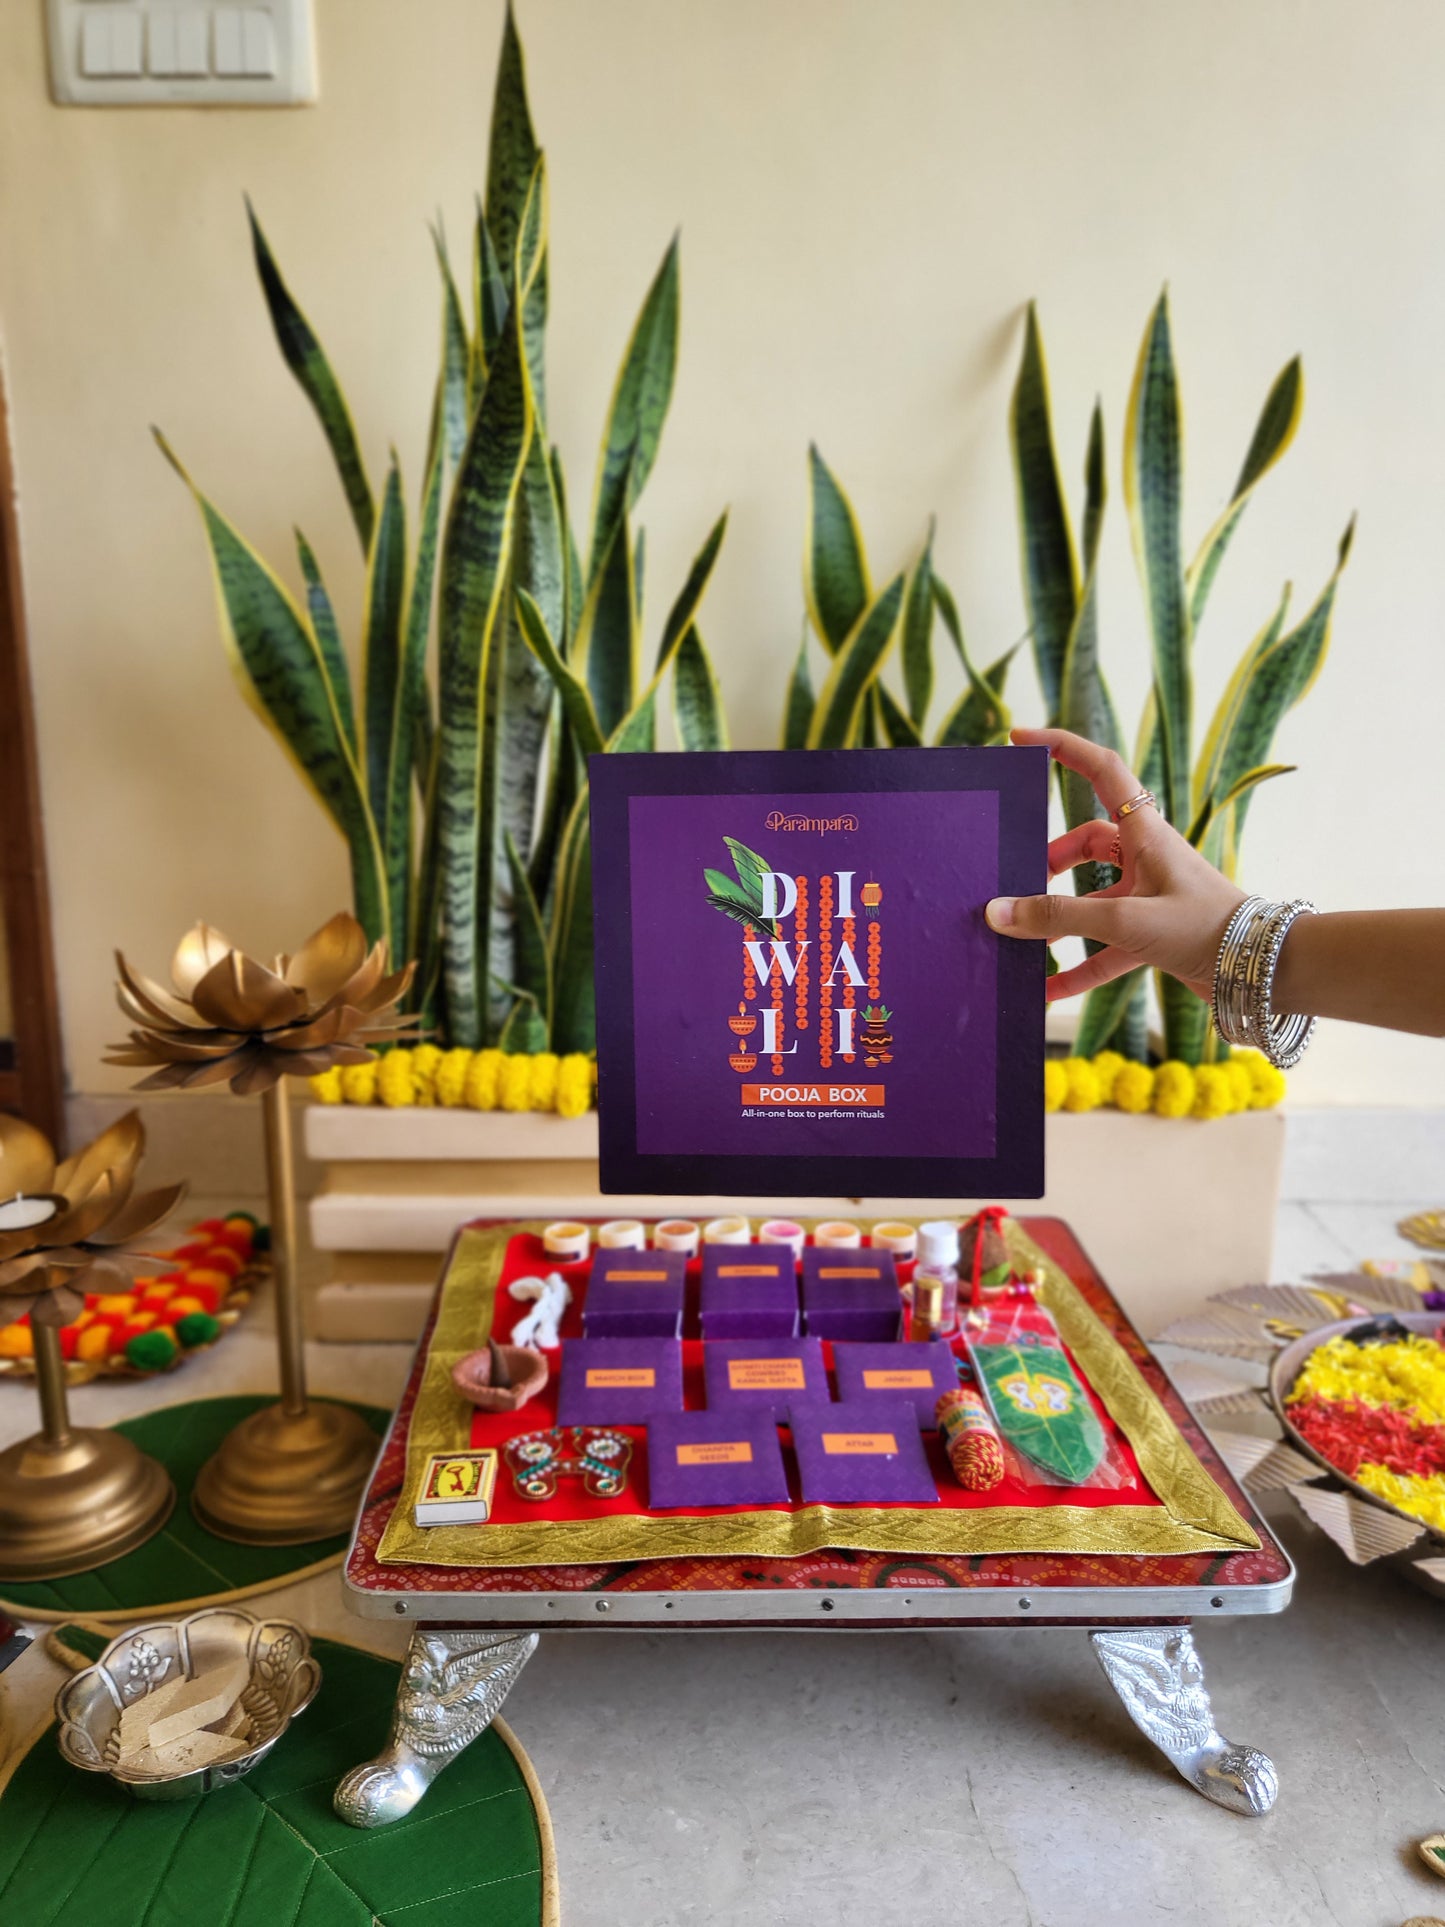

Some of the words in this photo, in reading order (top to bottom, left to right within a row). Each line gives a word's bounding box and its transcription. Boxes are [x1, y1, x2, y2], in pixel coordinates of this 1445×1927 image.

[765, 811, 859, 836] Parampara
[760, 1087, 821, 1102] POOJA
[829, 1087, 867, 1102] BOX
[741, 1109, 786, 1118] All-in-one
[787, 1109, 804, 1118] box
[806, 1109, 816, 1118] to
[818, 1109, 855, 1120] perform
[856, 1109, 885, 1119] rituals
